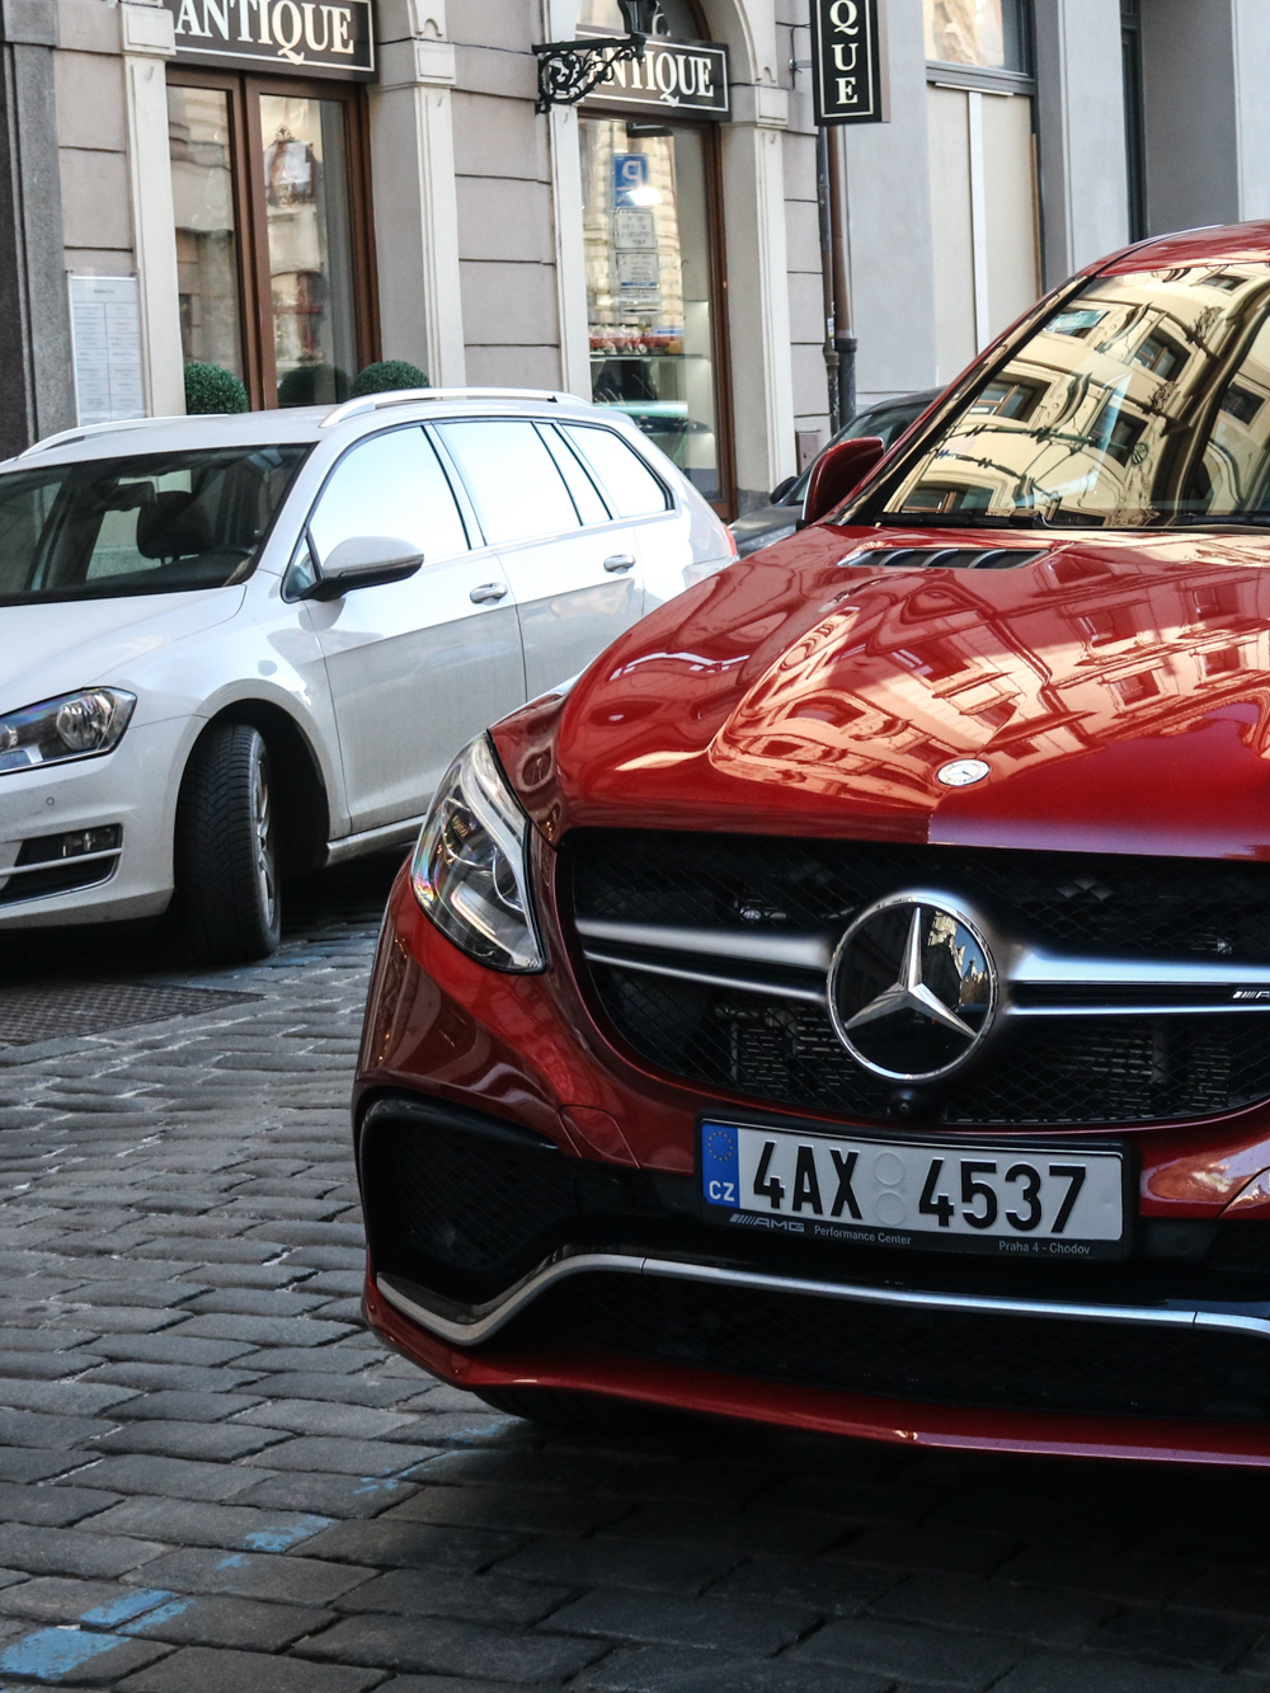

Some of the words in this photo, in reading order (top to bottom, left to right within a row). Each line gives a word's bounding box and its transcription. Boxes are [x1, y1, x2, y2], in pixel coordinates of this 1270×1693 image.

[175, 0, 354, 65] ANTIQUE
[709, 1180, 735, 1202] CZ
[753, 1140, 863, 1220] 4AX
[919, 1157, 1087, 1233] 4537
[814, 1225, 876, 1243] Performance
[878, 1232, 912, 1245] Center
[999, 1241, 1029, 1253] Praha
[1032, 1242, 1040, 1253] 4
[1050, 1242, 1091, 1255] Chodov
